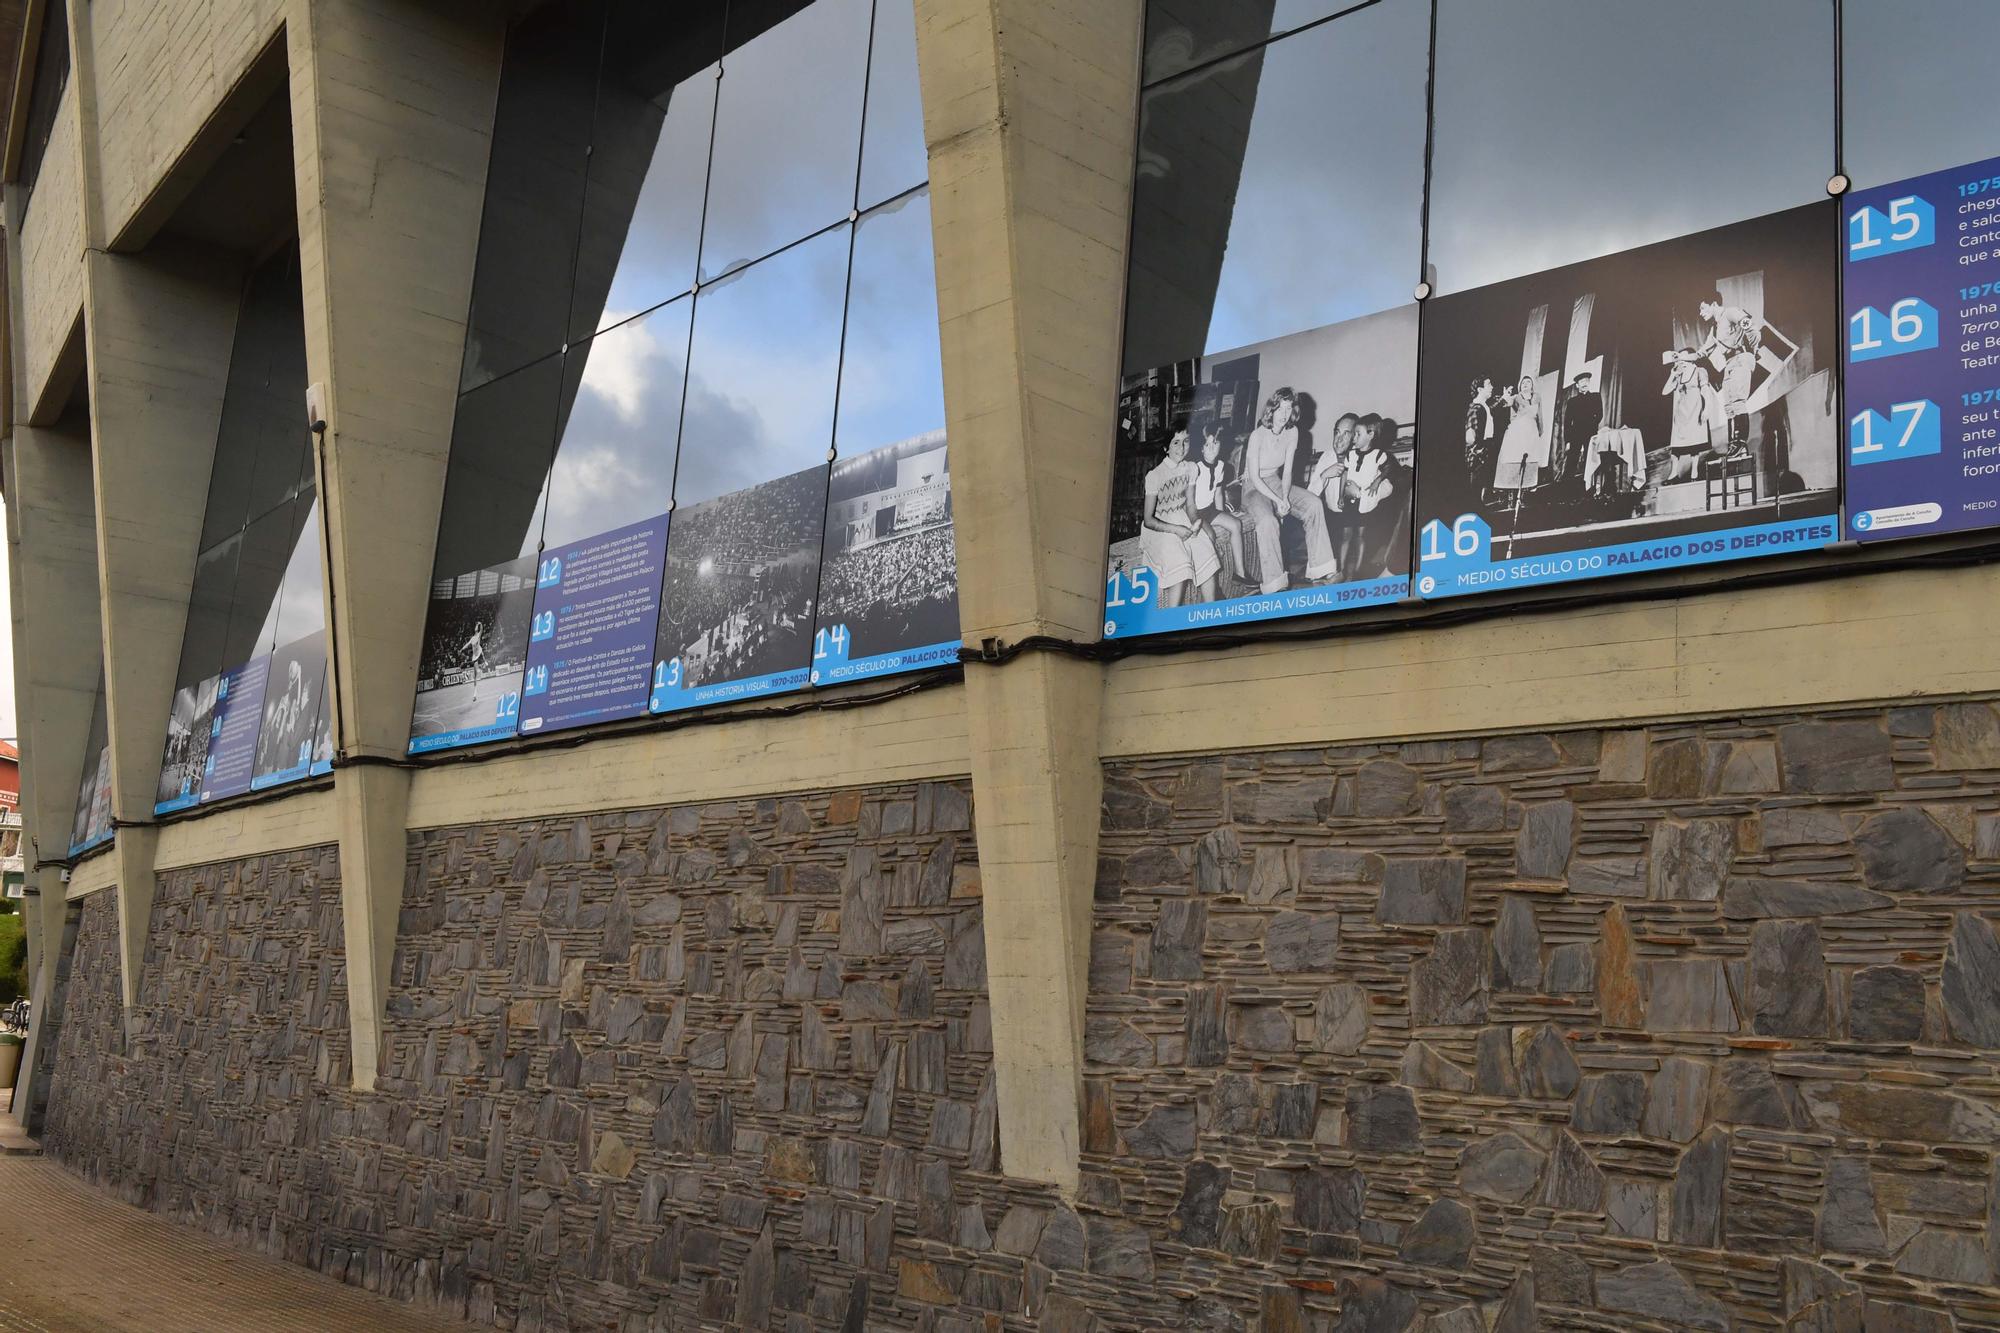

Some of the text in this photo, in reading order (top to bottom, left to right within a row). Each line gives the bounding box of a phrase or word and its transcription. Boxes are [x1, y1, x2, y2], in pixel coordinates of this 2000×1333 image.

[1958, 176, 2000, 197] 1975
[1849, 196, 1920, 251] 15
[1958, 221, 1968, 231] e
[1959, 251, 1988, 266] que
[1960, 281, 2000, 301] 1976
[1960, 303, 1997, 318] unha
[1850, 298, 1923, 352] 16
[1960, 340, 1980, 353] de
[1851, 400, 1927, 454] 17
[1962, 412, 1988, 424] seu
[1962, 428, 1996, 442] ante
[1963, 500, 1997, 511] MEDIO
[1420, 513, 1480, 562] 16
[1457, 524, 1833, 587] MEDIO SÉCULO DO PALACIO DOS DEPORTES
[539, 556, 559, 583] 12
[1105, 567, 1150, 608] 15
[1187, 582, 1409, 624] UNHA HISTORIA VISUAL 1970-2020
[533, 610, 553, 636] 13
[814, 623, 845, 660] 14
[654, 657, 680, 689] 13
[829, 647, 959, 678] MEDIO SÉCULO DO PALACIO DOS
[526, 664, 546, 690] 14
[695, 673, 808, 701] UNHA HISTORIA VISUAL 1970-2020
[496, 692, 517, 717] 12
